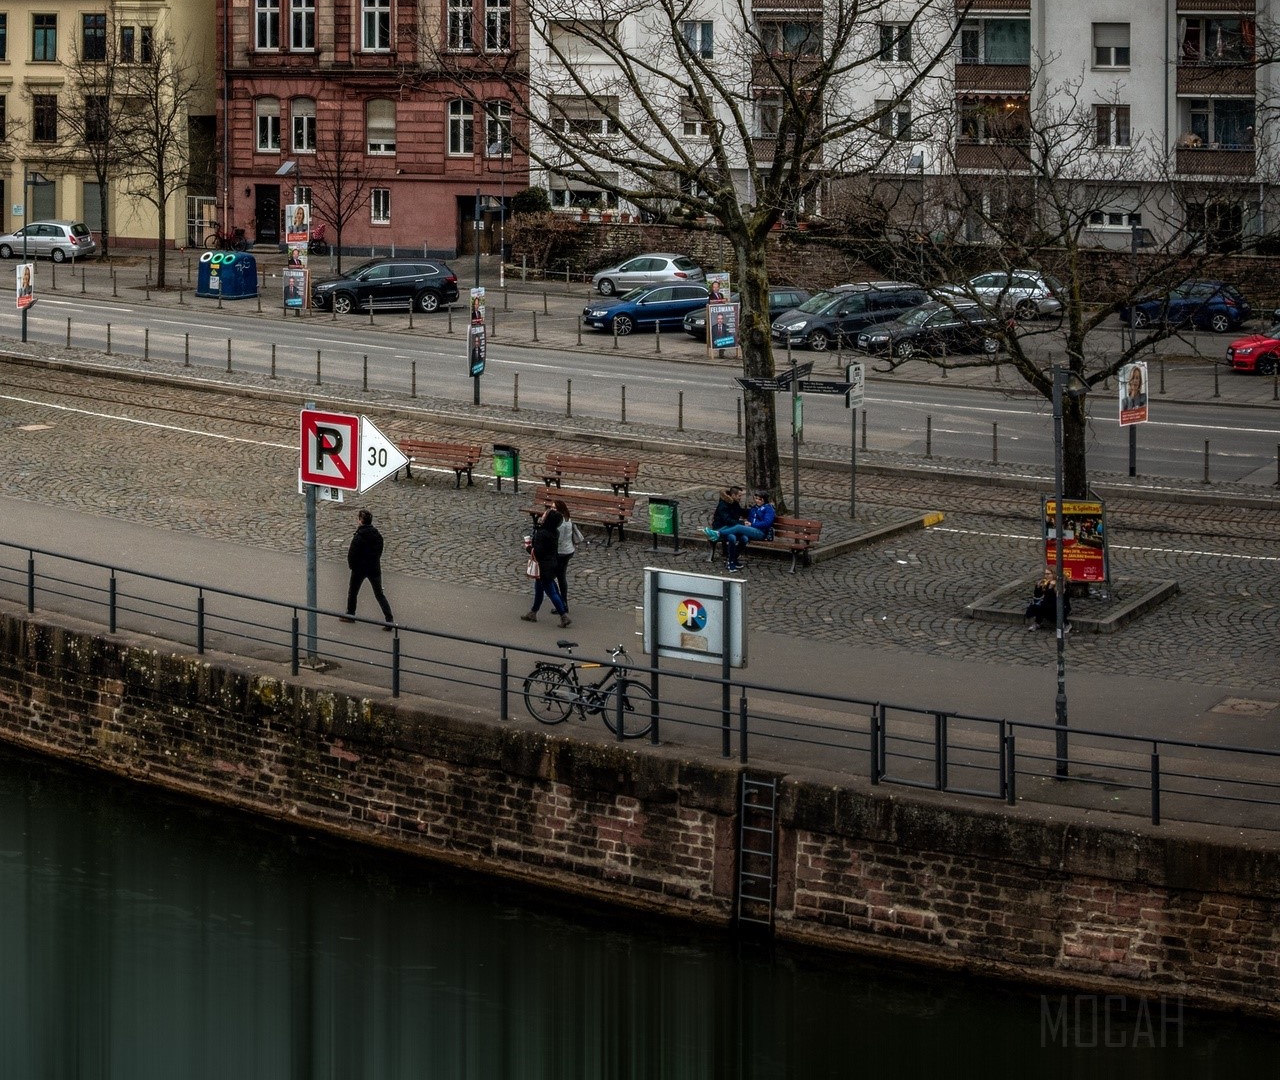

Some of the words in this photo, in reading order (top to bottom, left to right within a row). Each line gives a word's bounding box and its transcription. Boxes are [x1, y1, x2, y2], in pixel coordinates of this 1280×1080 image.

[316, 427, 343, 471] P
[367, 446, 388, 468] 30
[686, 604, 698, 627] P
